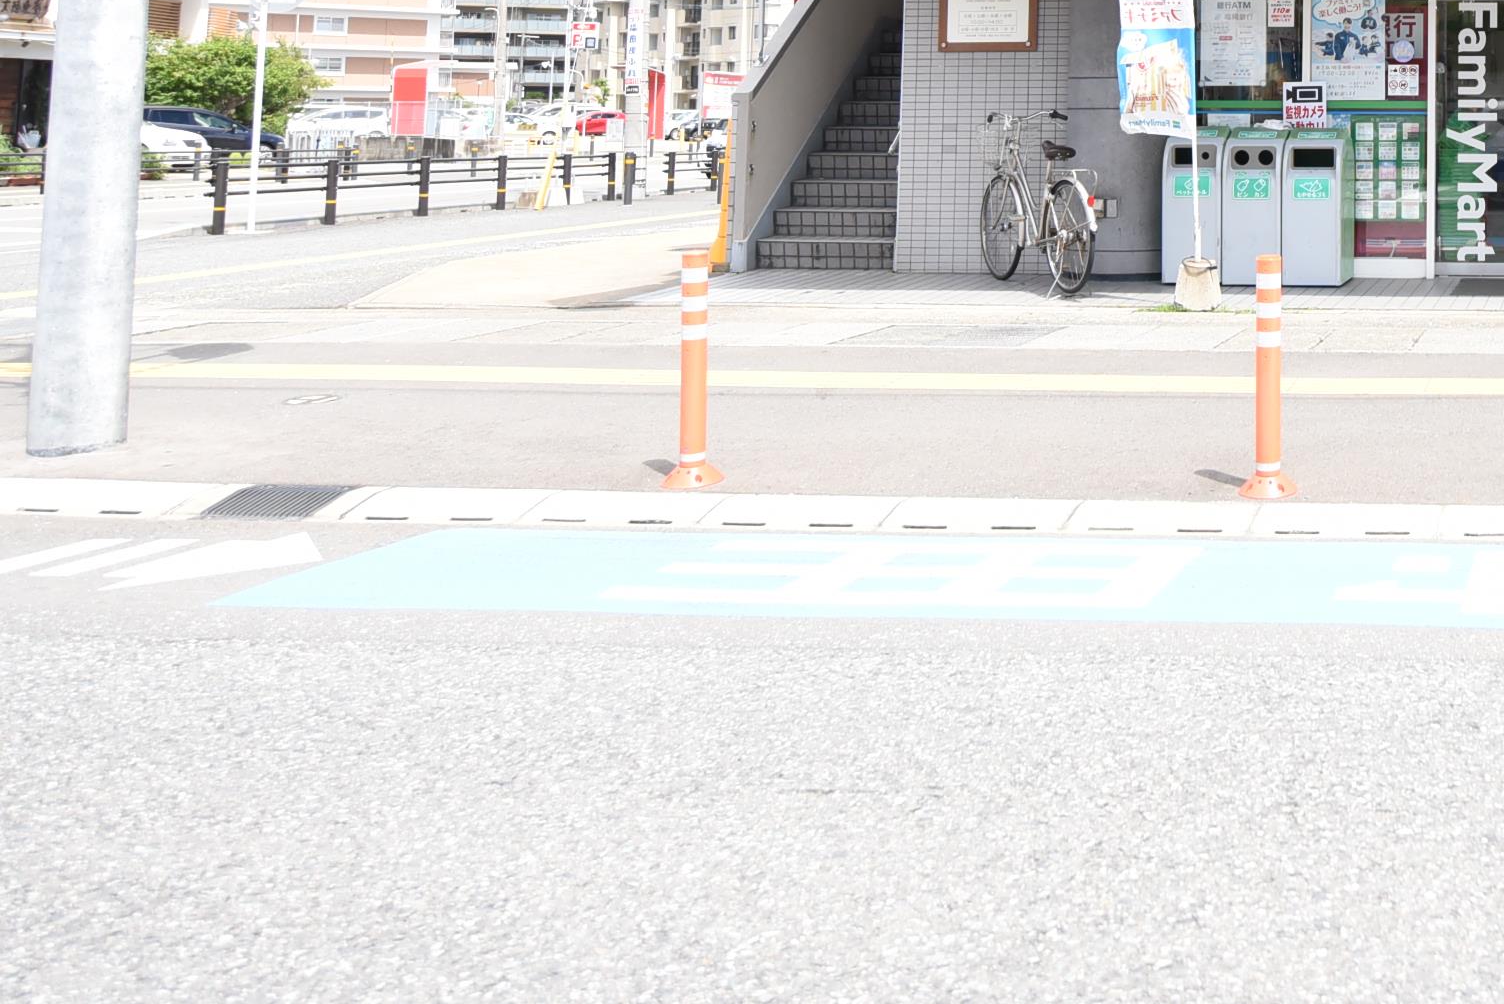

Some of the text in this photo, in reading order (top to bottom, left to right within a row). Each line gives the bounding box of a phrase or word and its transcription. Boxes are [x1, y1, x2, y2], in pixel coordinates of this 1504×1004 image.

[1285, 105, 1324, 119] 監視カメラ
[1446, 0, 1498, 262] FamilyMart
